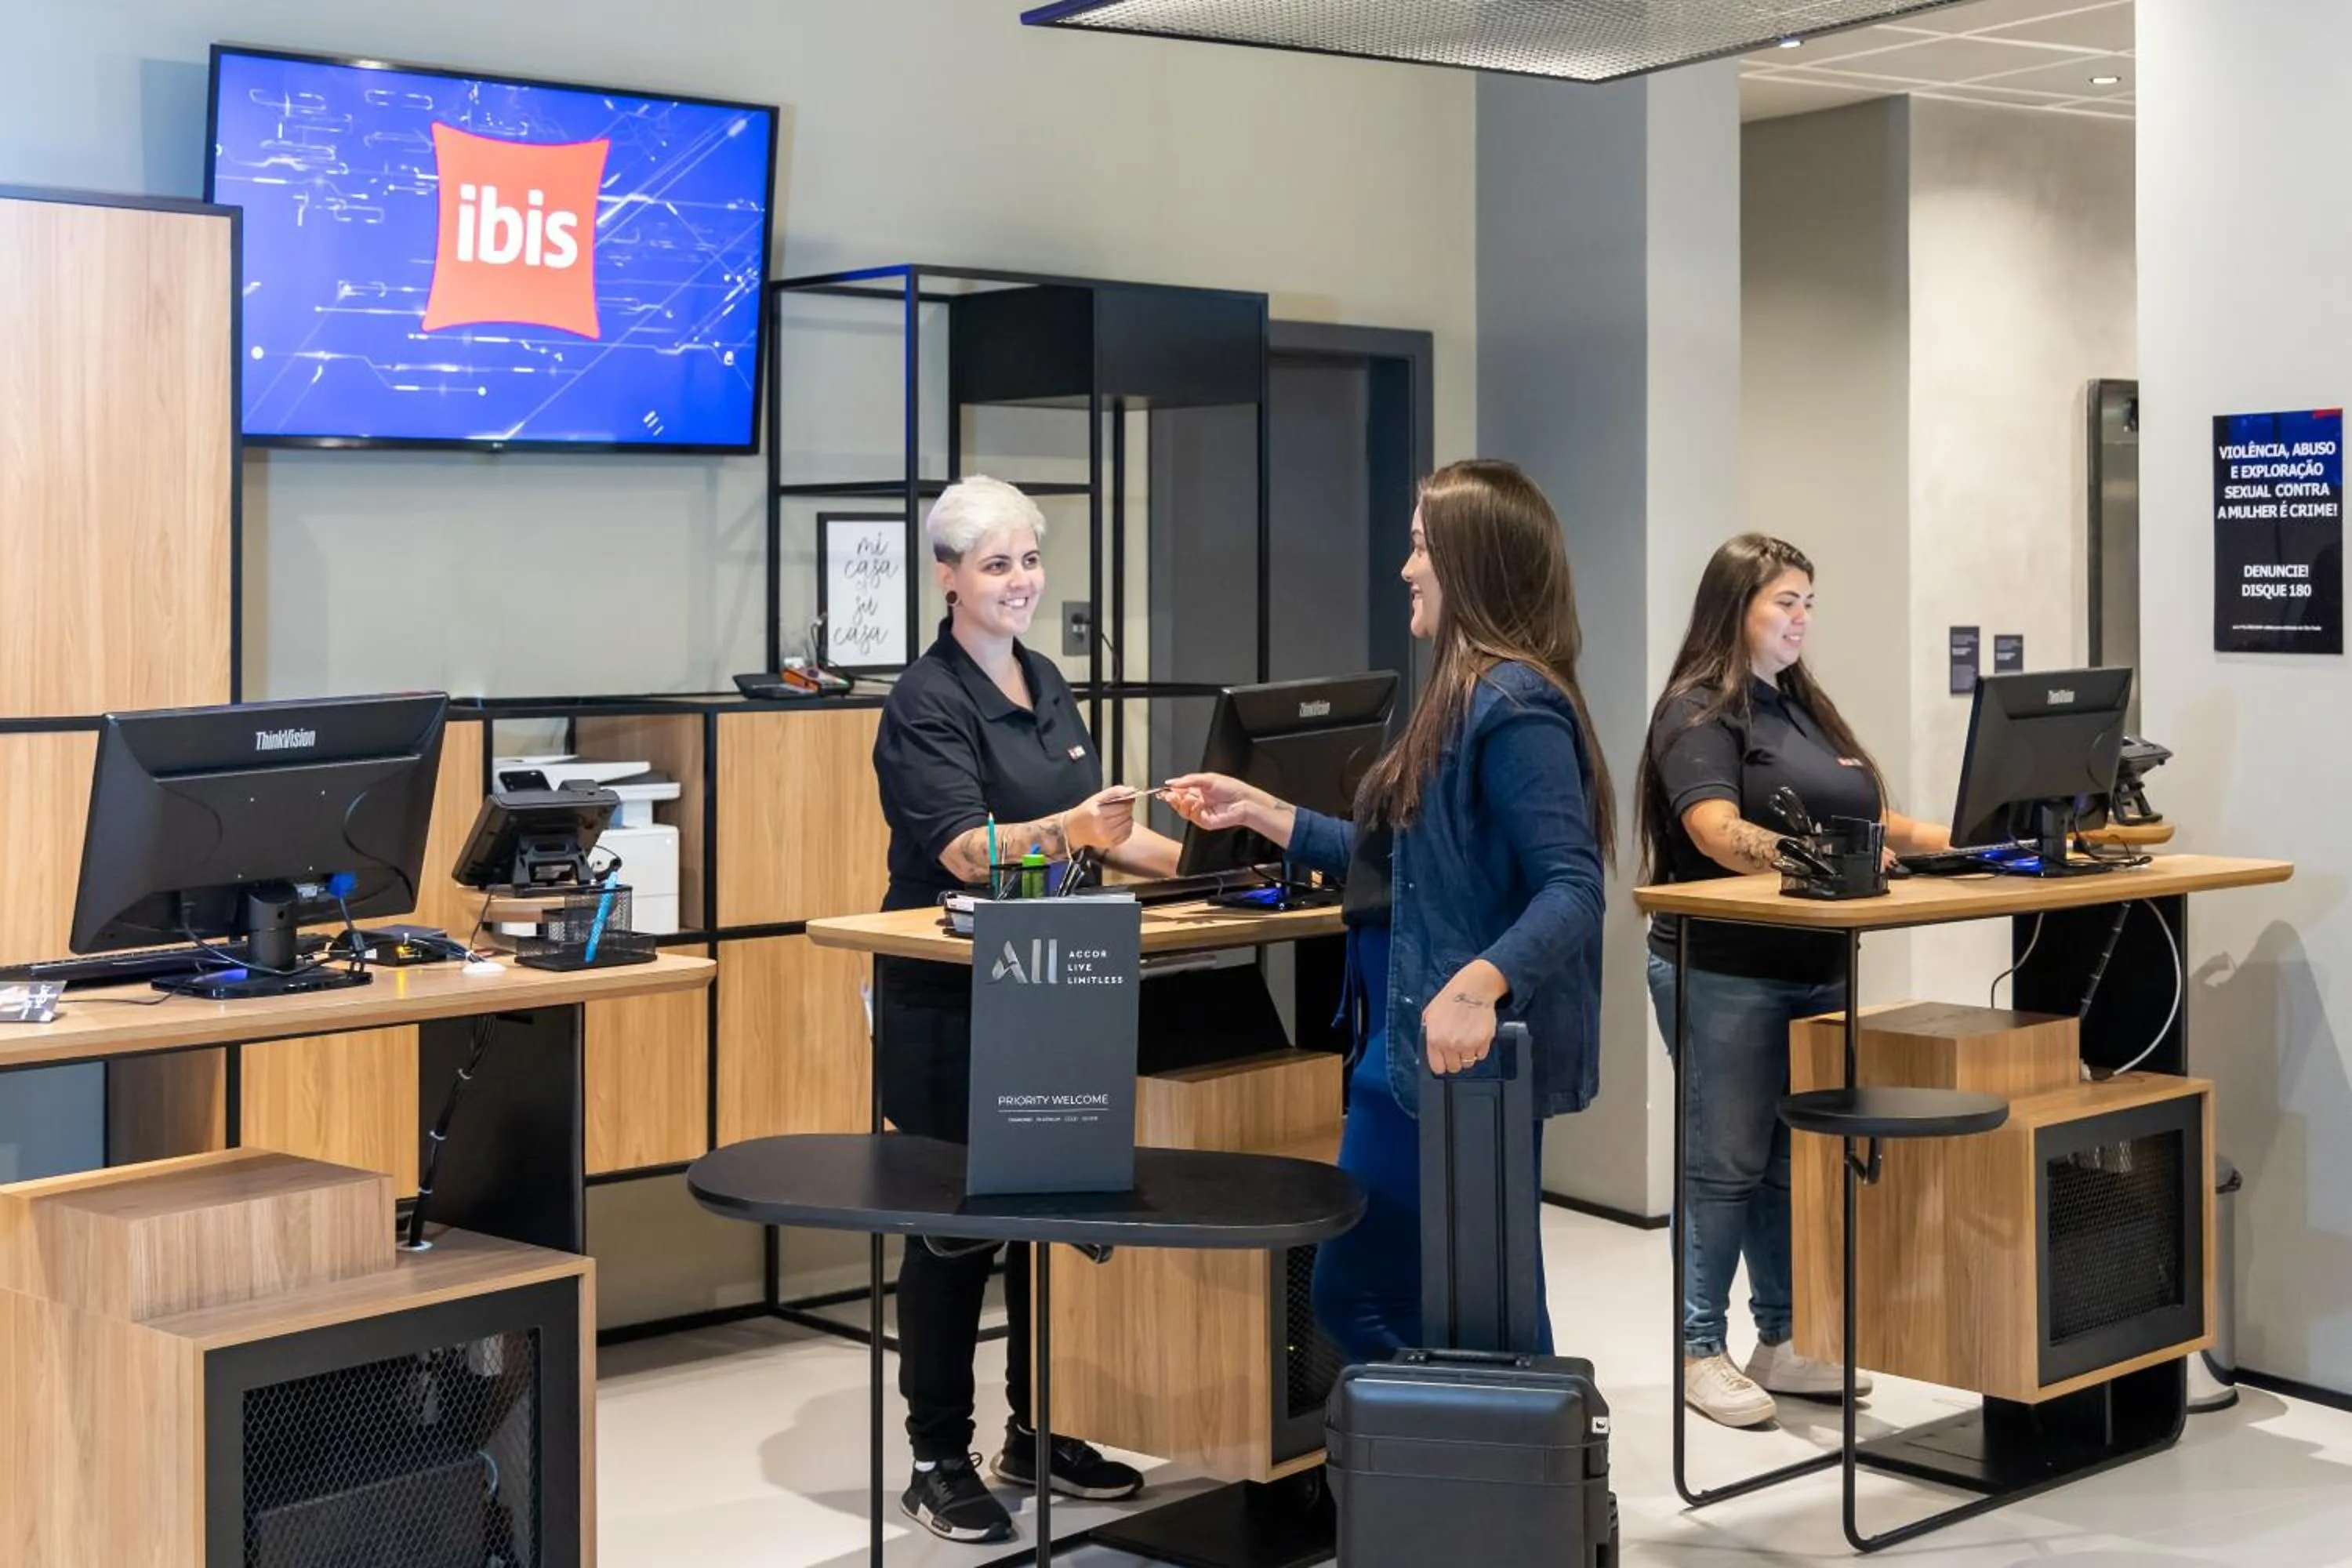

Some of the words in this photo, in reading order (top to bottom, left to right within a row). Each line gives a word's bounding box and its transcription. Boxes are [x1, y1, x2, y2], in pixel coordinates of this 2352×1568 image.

[457, 183, 578, 269] ibis
[2219, 440, 2290, 459] VIOLÊNCIA,
[2292, 441, 2336, 456] ABUSO
[2230, 465, 2239, 479] E
[2241, 459, 2324, 479] EXPLORAÇÃO
[2224, 485, 2271, 499] SEXUAL
[2274, 482, 2330, 497] CONTRA
[2217, 506, 2227, 519] A
[2227, 504, 2278, 519] MULHER
[2280, 500, 2288, 517] É
[2288, 503, 2338, 517] CRIME!
[2244, 564, 2309, 578] DENUNCIE!
[2241, 583, 2287, 600] DISQUE
[2288, 583, 2312, 597] 180
[255, 728, 316, 750] ThinkVision
[1069, 949, 1108, 958] ACCOR
[997, 1094, 1050, 1105] PRIORITY
[1051, 1094, 1109, 1105] WELCOME
